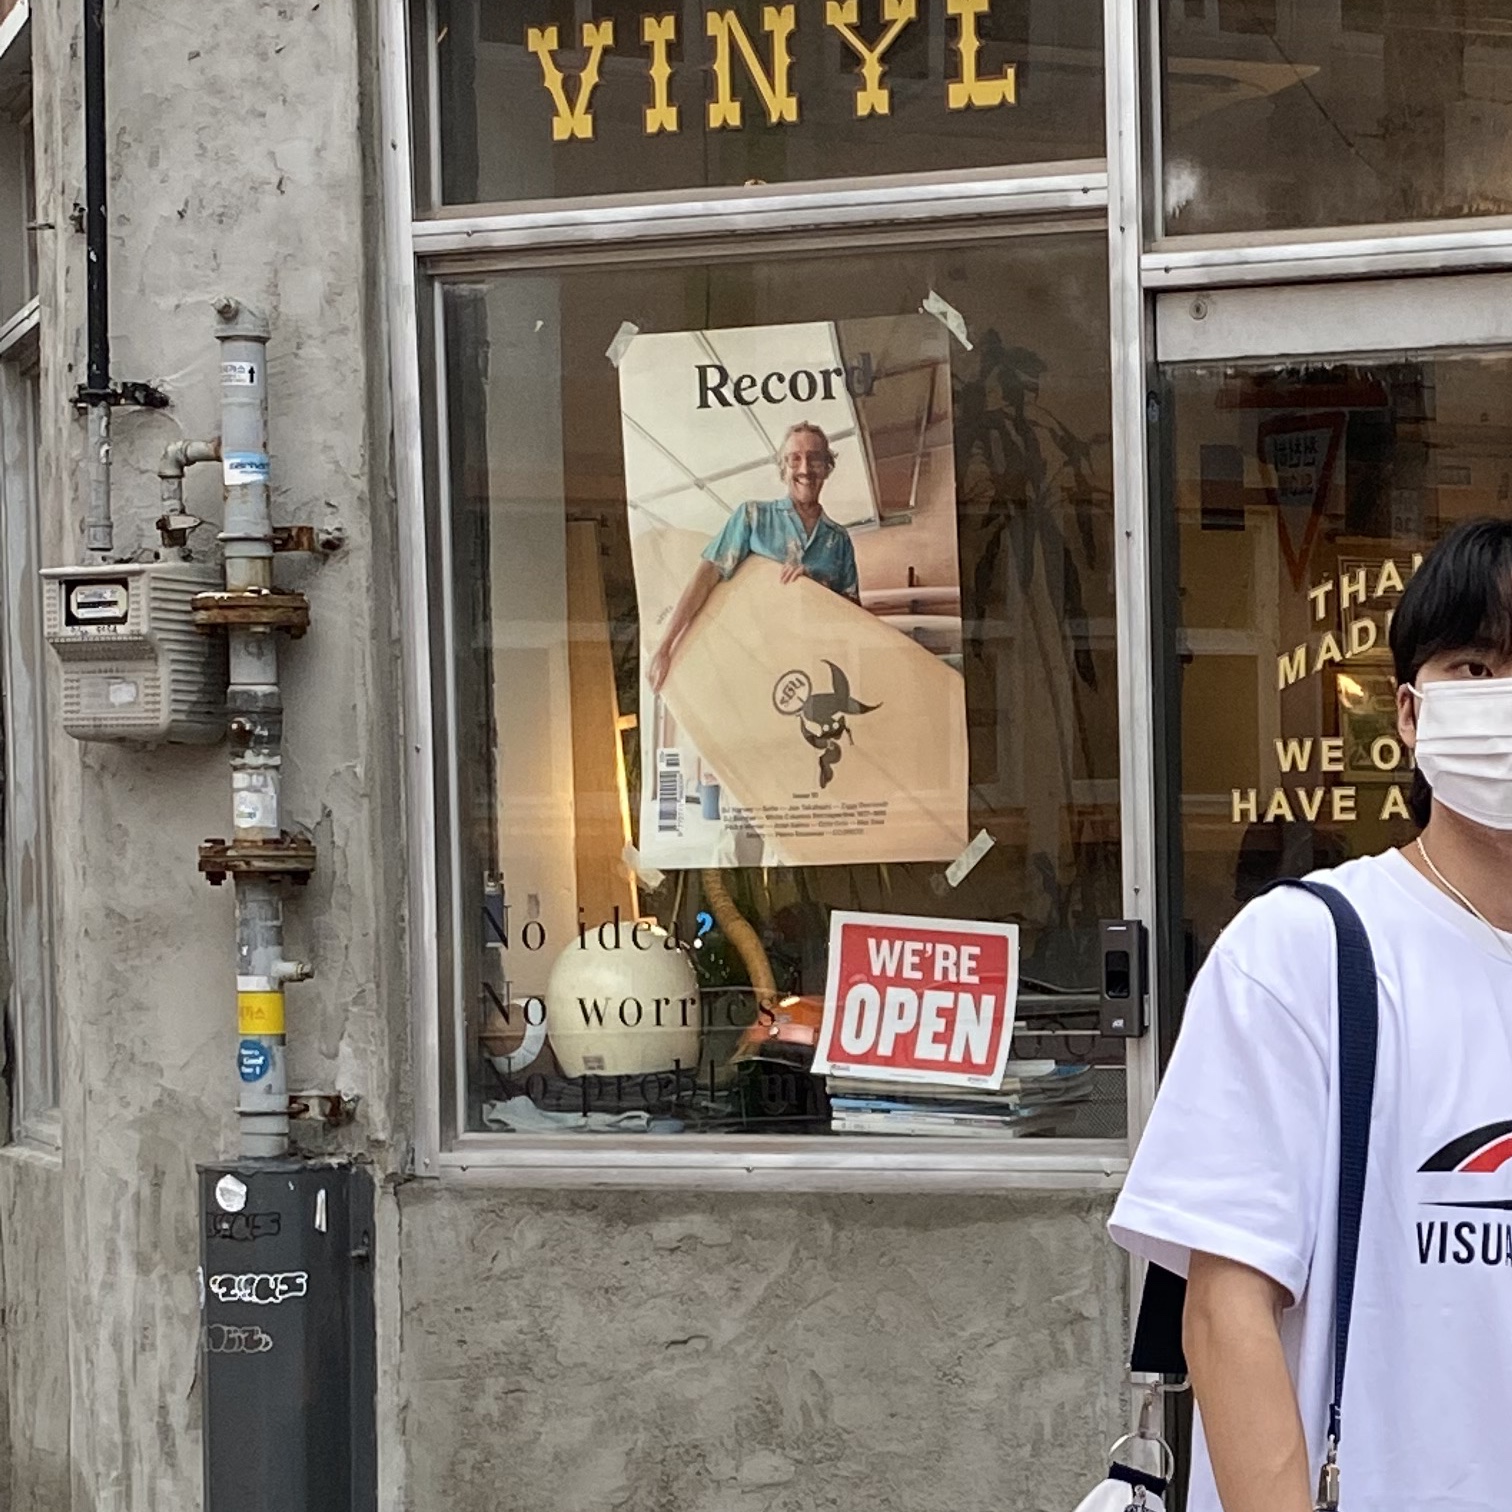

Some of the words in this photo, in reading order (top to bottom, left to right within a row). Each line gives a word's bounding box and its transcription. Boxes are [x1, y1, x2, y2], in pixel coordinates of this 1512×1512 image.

[527, 0, 1017, 141] VINYL
[694, 353, 876, 409] Record
[1276, 737, 1344, 772] WE
[1370, 736, 1415, 770] O
[1231, 786, 1357, 822] HAVE
[1379, 785, 1410, 820] A
[482, 905, 546, 950] No
[867, 937, 981, 985] WE'RE
[481, 981, 548, 1027] No
[577, 996, 778, 1028] worries
[840, 973, 996, 1066] OPEN
